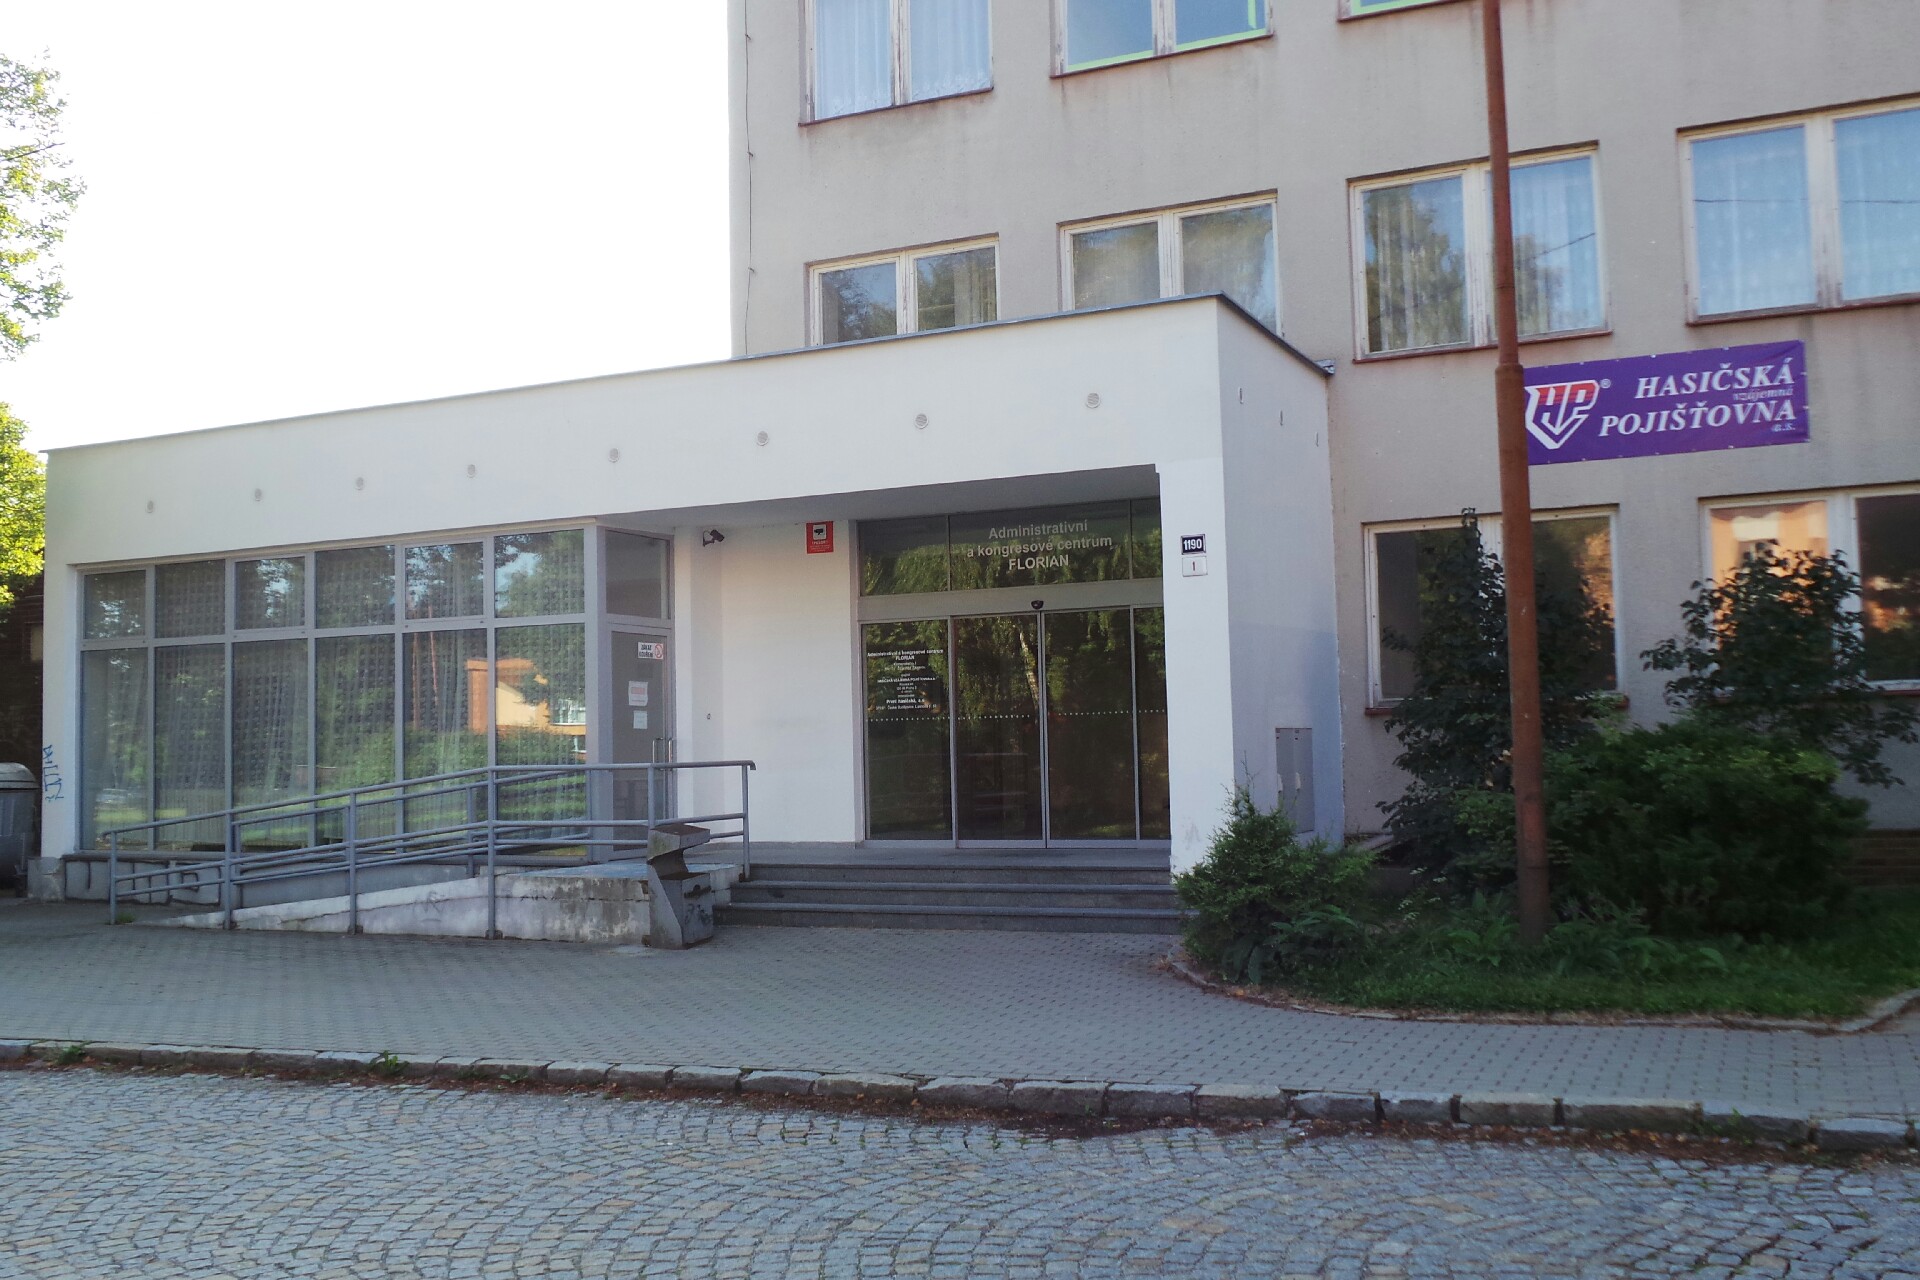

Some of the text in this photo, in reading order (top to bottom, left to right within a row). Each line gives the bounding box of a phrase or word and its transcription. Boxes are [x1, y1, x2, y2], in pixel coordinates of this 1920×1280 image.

[1634, 357, 1795, 399] HASIČSKÁ
[1598, 400, 1796, 437] POJIŠŤOVNA
[989, 520, 1088, 539] Administrativní
[967, 537, 1112, 557] a kongresové centrum
[1183, 538, 1202, 551] 1190
[1008, 554, 1069, 570] FLORIAN
